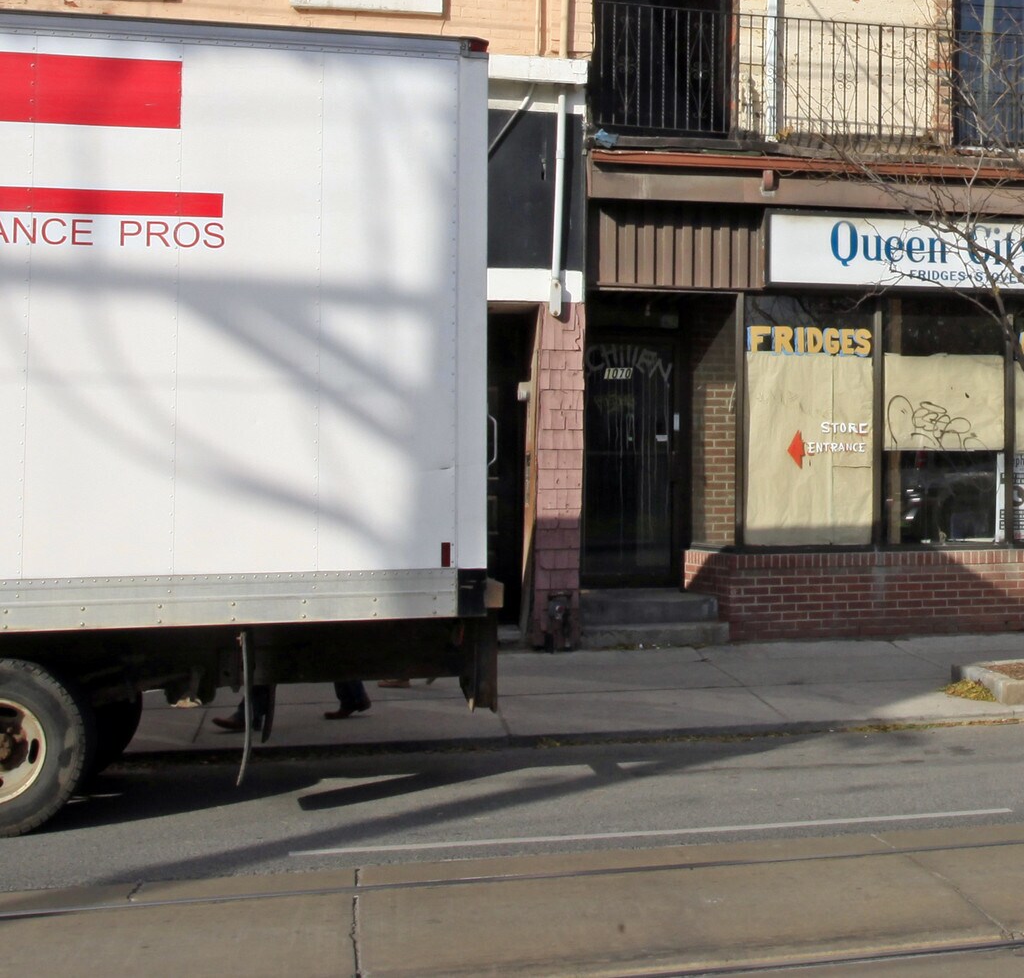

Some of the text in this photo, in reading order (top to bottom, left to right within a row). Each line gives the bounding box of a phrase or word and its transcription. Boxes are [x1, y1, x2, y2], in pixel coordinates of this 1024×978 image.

[119, 220, 225, 249] PROS
[830, 220, 948, 267] Queen
[910, 269, 966, 282] FRIDGES
[747, 325, 872, 357] FRIDGES
[605, 368, 633, 379] 1070
[821, 422, 869, 434] STORE
[807, 441, 866, 454] ENTRANCE
